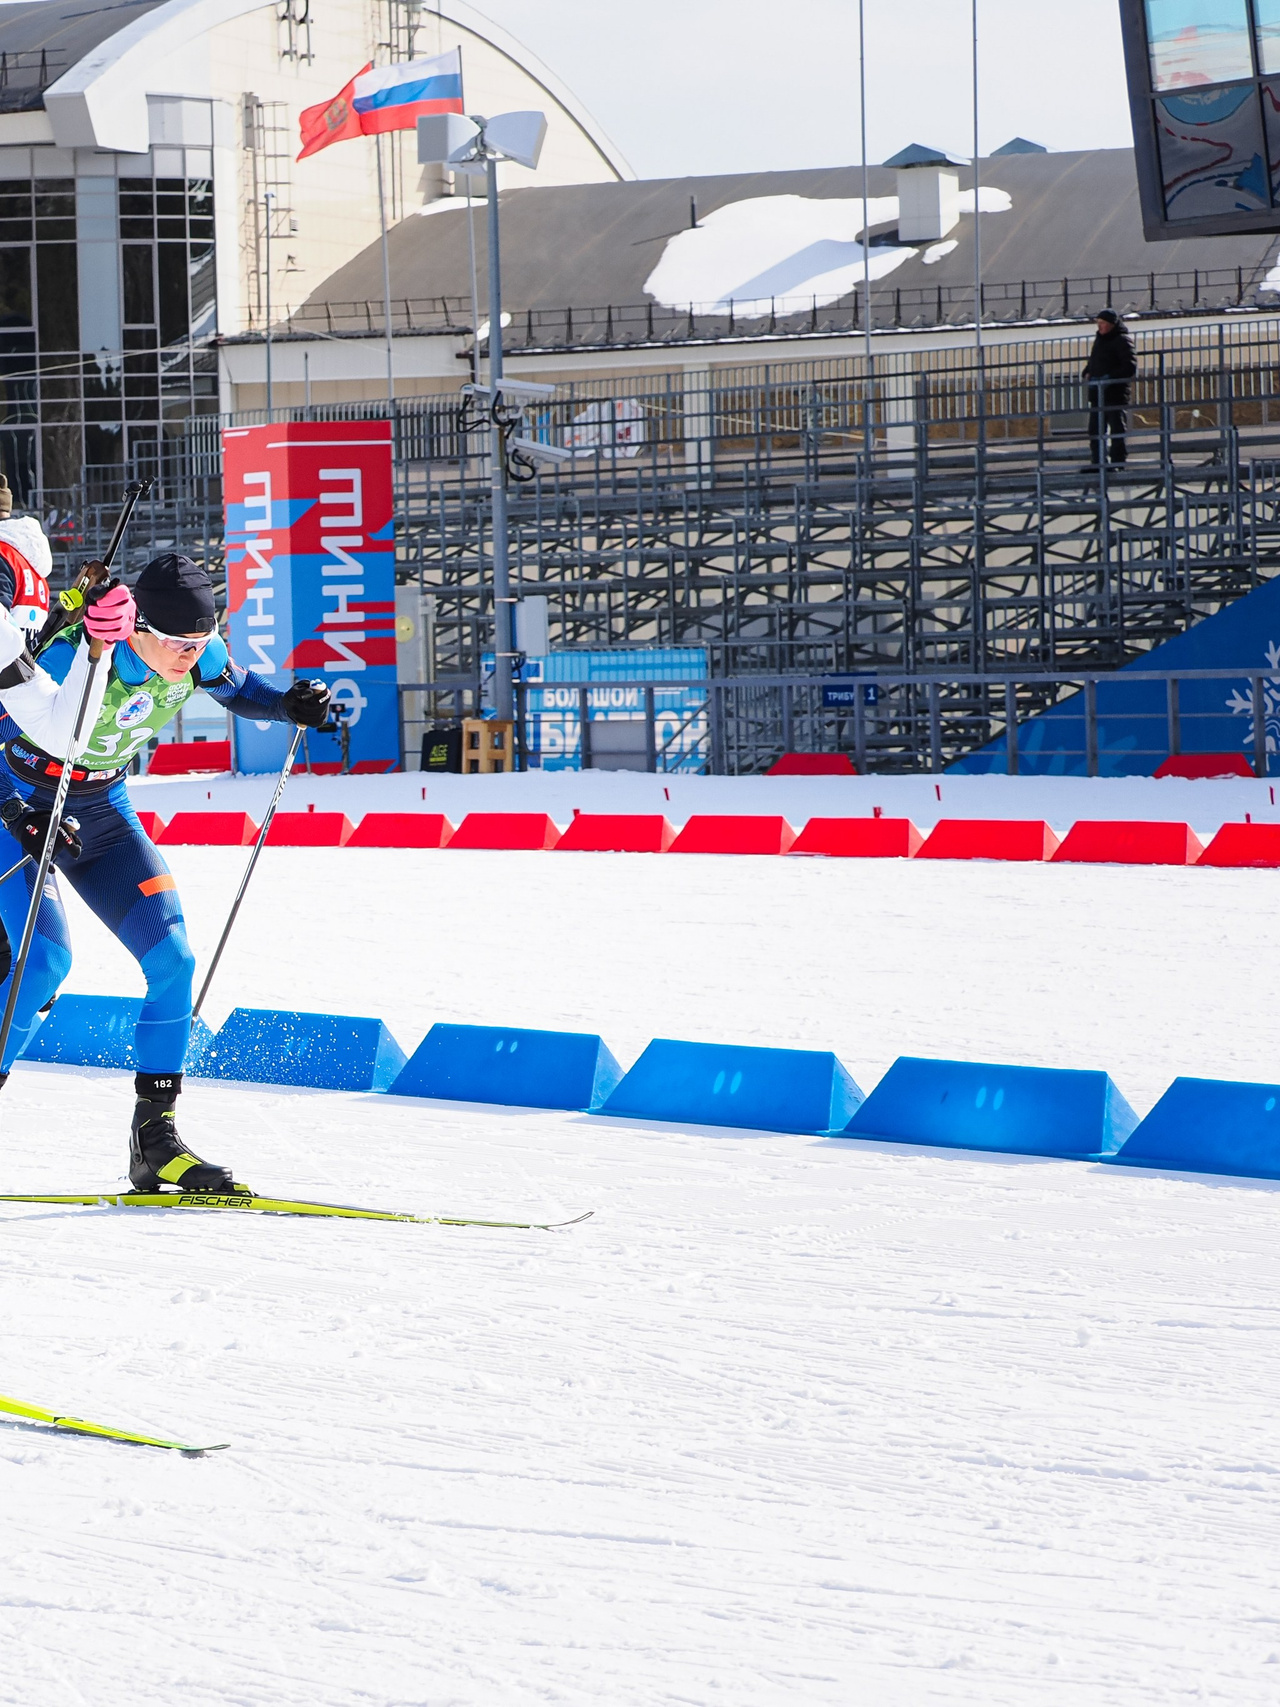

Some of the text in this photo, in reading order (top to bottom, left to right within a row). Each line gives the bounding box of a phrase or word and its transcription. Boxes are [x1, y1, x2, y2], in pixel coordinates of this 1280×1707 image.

[243, 471, 276, 730] ИНИШ
[319, 468, 367, 728] ФИНИШ
[867, 687, 876, 700] 1
[84, 726, 154, 758] 32
[153, 1079, 173, 1089] 182
[178, 1195, 253, 1208] FISCHER
